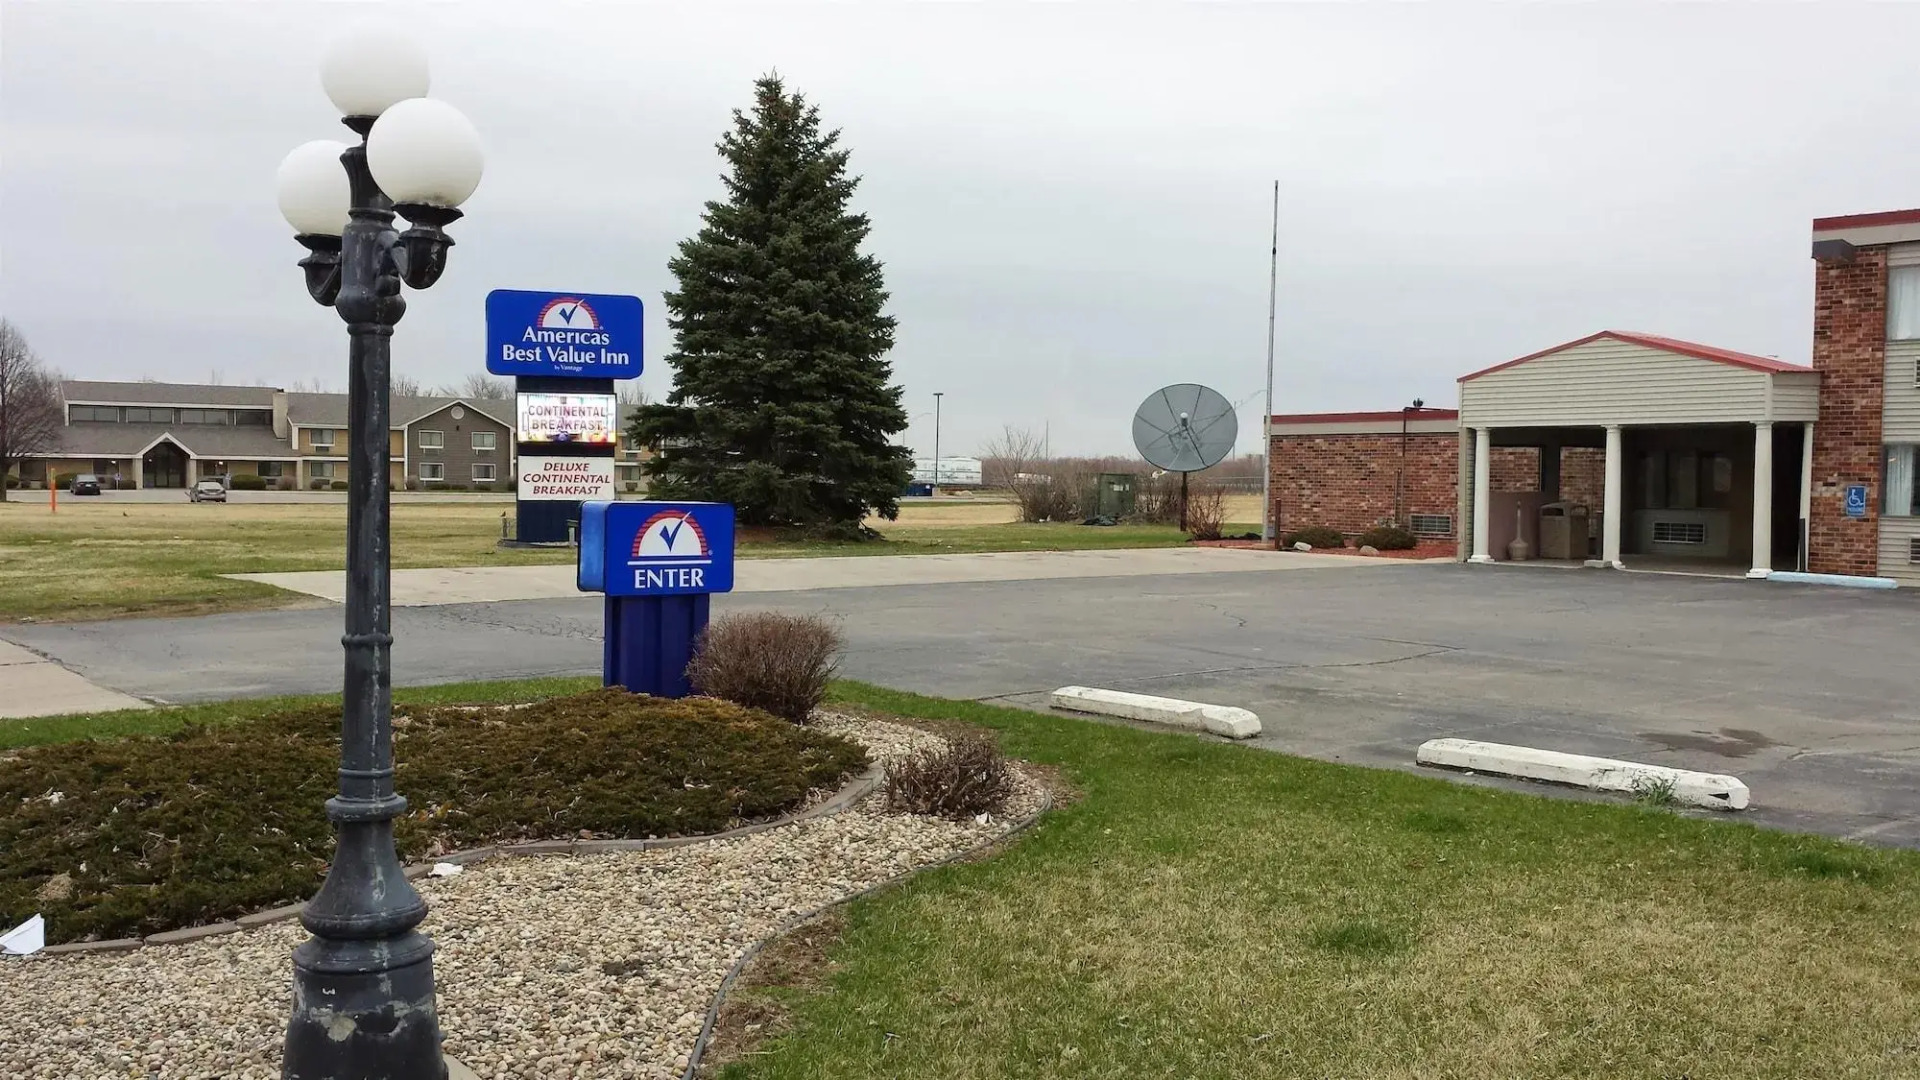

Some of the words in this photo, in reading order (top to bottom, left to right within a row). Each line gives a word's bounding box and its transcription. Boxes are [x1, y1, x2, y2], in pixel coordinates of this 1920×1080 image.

[522, 326, 610, 345] Americas
[502, 344, 542, 362] Best
[546, 346, 595, 363] Value
[600, 348, 629, 365] Inn
[528, 405, 606, 417] CONTINENTAL
[531, 419, 602, 430] BREAKFAST
[543, 462, 590, 471] DELUXE
[523, 474, 611, 484] CONTINENTAL
[533, 485, 601, 495] BREAKFAST
[634, 568, 704, 589] ENTER
